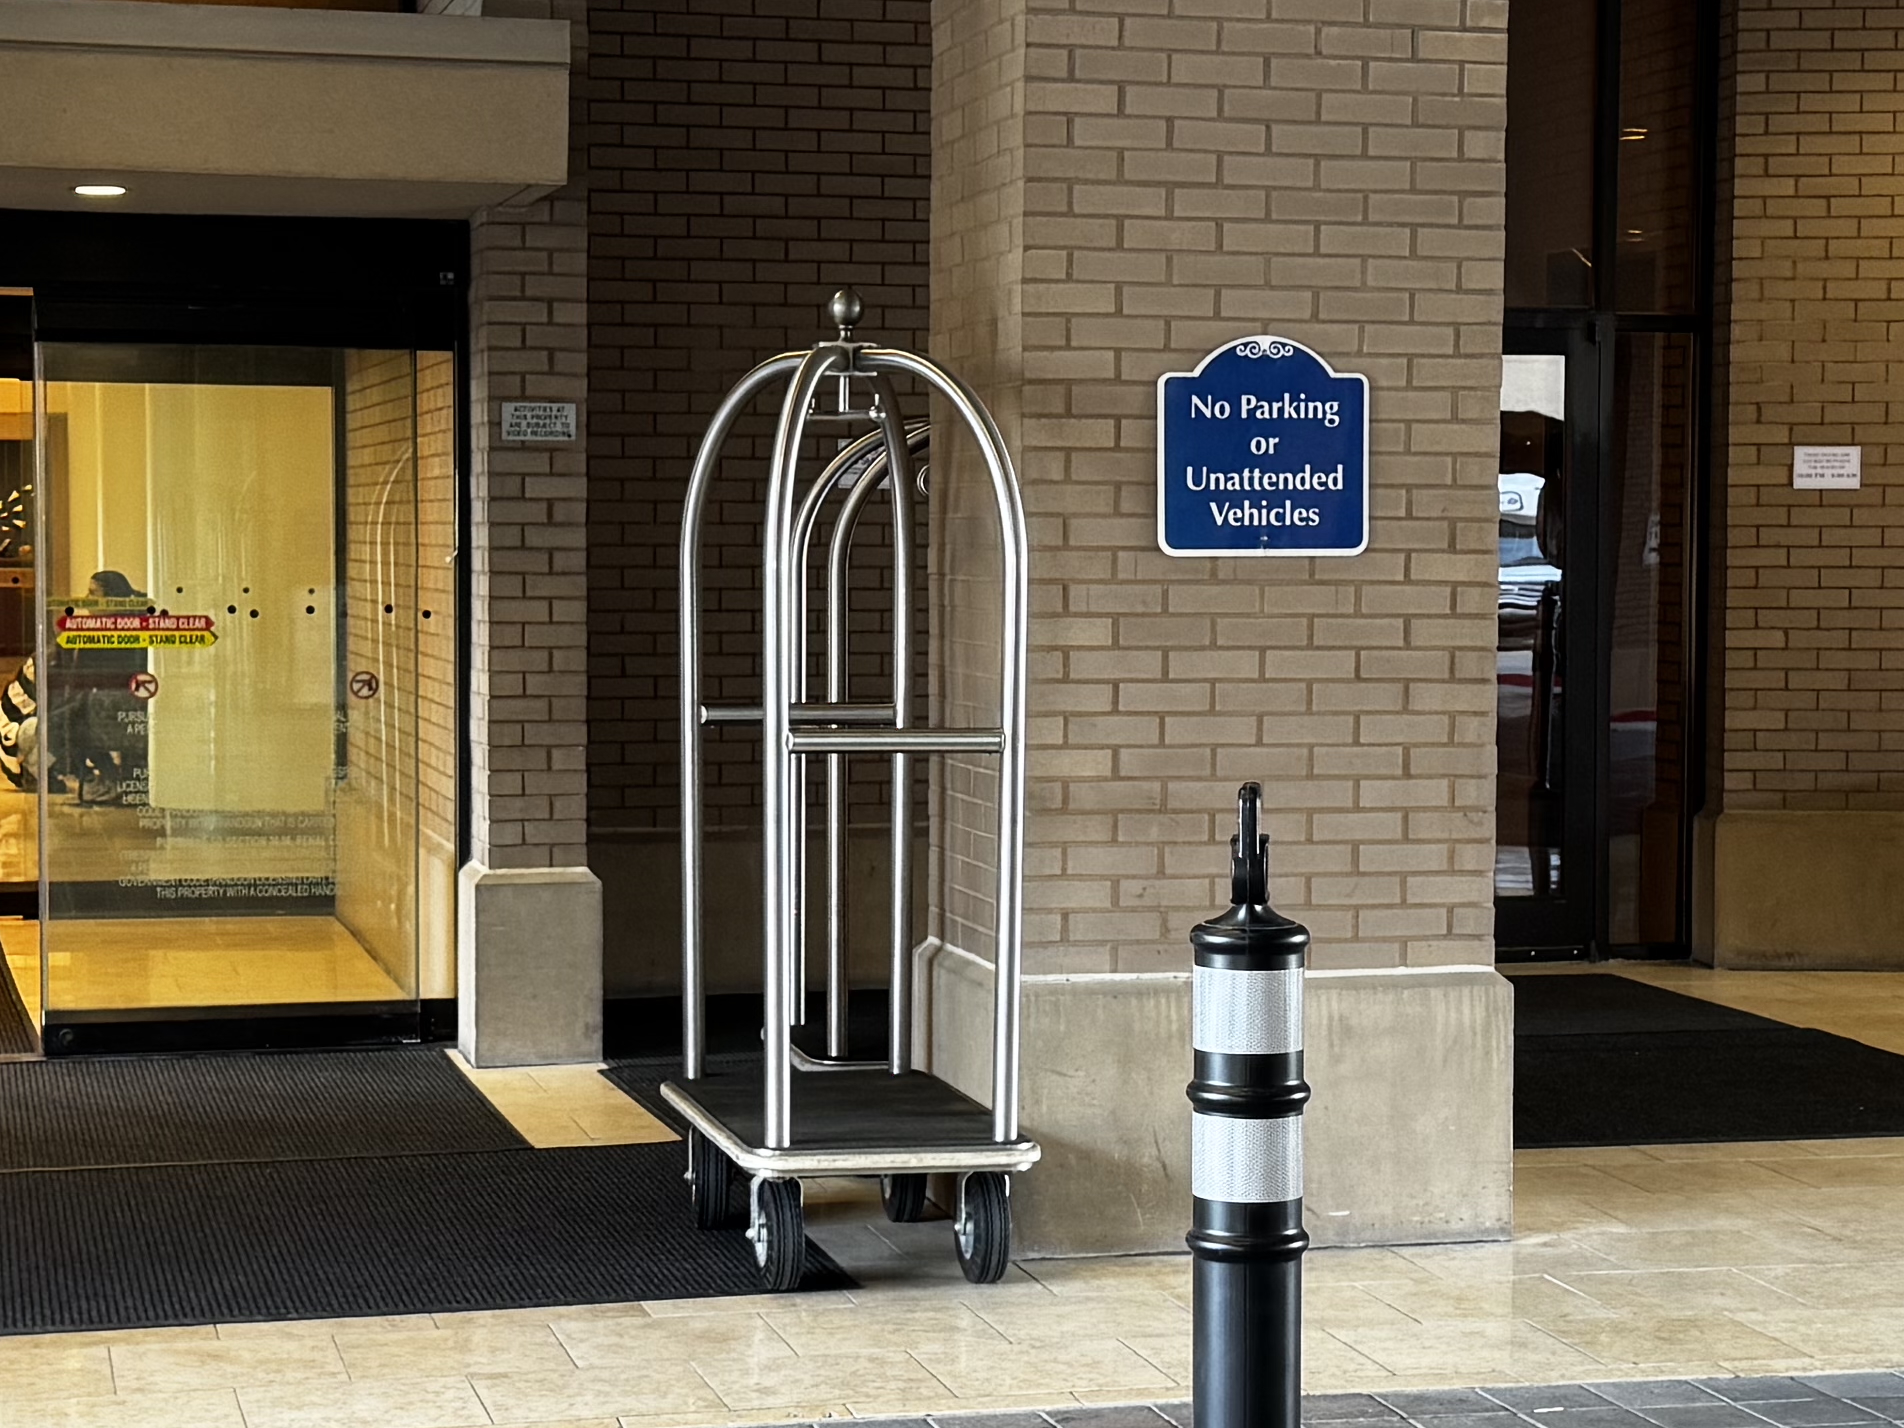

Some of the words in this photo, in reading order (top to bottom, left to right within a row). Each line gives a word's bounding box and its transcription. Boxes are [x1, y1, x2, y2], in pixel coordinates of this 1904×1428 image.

[1191, 394, 1230, 418] No
[1241, 393, 1340, 427] Parking
[1250, 436, 1279, 454] or
[1186, 464, 1343, 491] Unattended
[1209, 500, 1320, 526] Vehicles
[65, 617, 115, 629] AUTOMATIC
[117, 617, 141, 629] DOOR
[149, 617, 177, 629] STAND
[179, 617, 206, 629] CLEAR
[65, 634, 115, 645] AUTOMATIC
[117, 634, 141, 645] DOOR
[149, 634, 176, 645] STAND
[179, 634, 206, 645] CLEAR
[156, 887, 176, 899] THIS
[177, 886, 223, 898] PROPERTY
